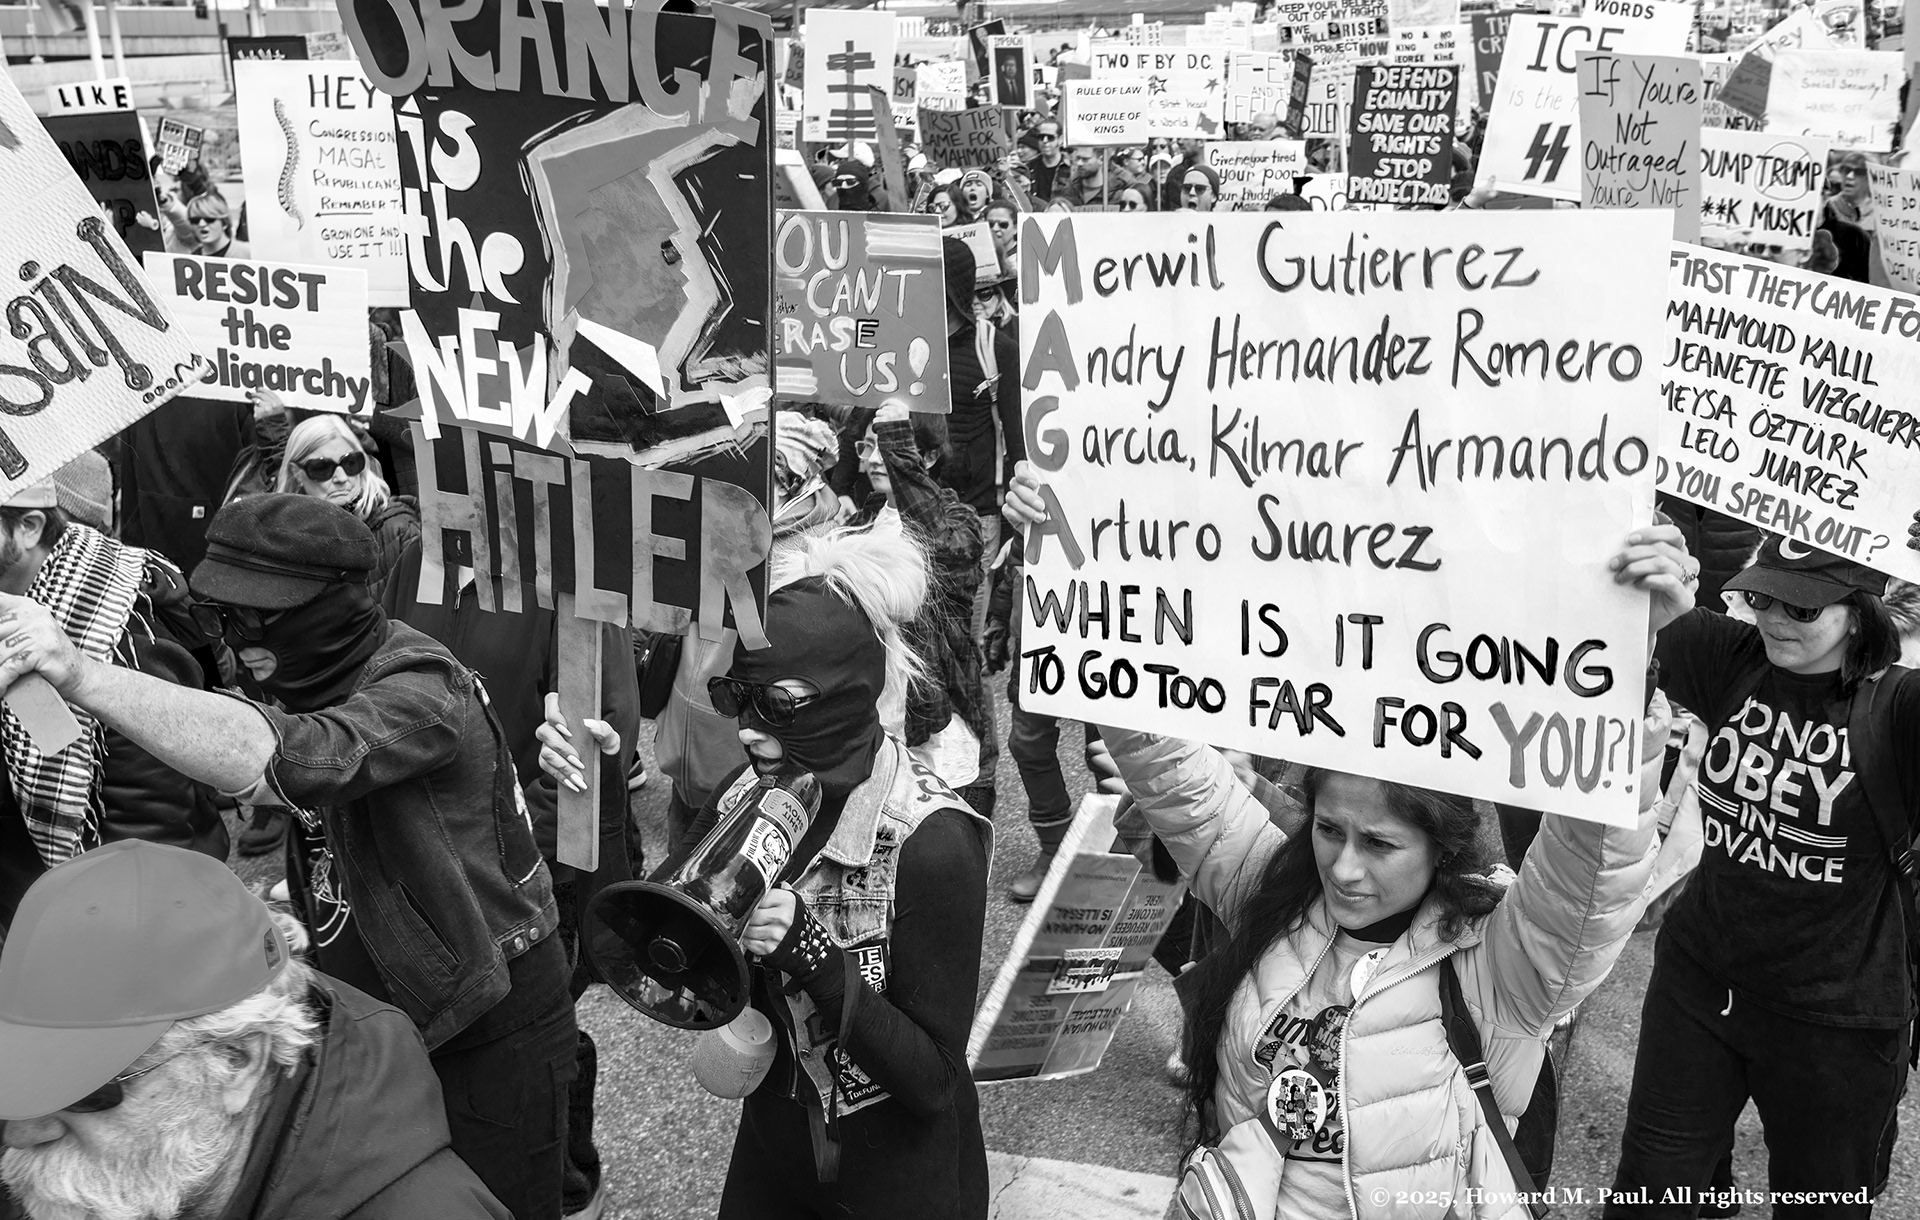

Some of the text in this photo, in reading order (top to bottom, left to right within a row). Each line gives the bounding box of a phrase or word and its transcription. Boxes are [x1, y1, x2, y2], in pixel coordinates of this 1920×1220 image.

[1277, 3, 1304, 13] KEEP
[1307, 1, 1338, 12] YOUR
[1288, 5, 1389, 22] OUT OF MY RIGHTS
[1594, 0, 1655, 20] WORDS
[1293, 21, 1375, 43] WE WILL RISE
[1401, 32, 1413, 40] NO
[1360, 41, 1389, 57] NOW
[1396, 43, 1416, 52] KING
[336, 0, 772, 147] ORANGE
[1096, 54, 1214, 70] TWO IF BY D.C.
[1371, 67, 1453, 90] DEFEND
[1584, 55, 1620, 107] If
[1801, 77, 1836, 89] Social
[58, 85, 128, 109] LIKE
[308, 74, 377, 109] HEY
[1077, 86, 1142, 96] RULE OF LAW
[1364, 89, 1452, 112] EQUALITY
[919, 108, 1002, 133] FIRST THEY
[1078, 112, 1141, 122] NOT RULE OF
[1357, 113, 1405, 135] SAVE
[1407, 113, 1450, 134] OUR
[1616, 111, 1658, 146] Not
[922, 130, 998, 148] CAME FOR
[1094, 125, 1125, 134] KINGS
[397, 95, 482, 192] is
[1370, 136, 1442, 156] RIGHTS
[933, 146, 1007, 168] MAHMOUD
[1272, 150, 1296, 163] tired
[1375, 158, 1432, 179] STOP
[1585, 140, 1687, 192] Outraged
[313, 168, 401, 191] REPUBLICANS
[1220, 168, 1299, 187] your poor
[1757, 155, 1822, 192] TRUMP
[1869, 168, 1899, 189] WHAT
[320, 196, 386, 210] REMEMBER
[1651, 178, 1689, 208] Not
[1751, 201, 1815, 238] MUSK!
[380, 226, 400, 238] AND
[400, 182, 525, 305] the
[328, 243, 353, 259] USE
[359, 242, 383, 258] IT
[776, 212, 849, 277] OU
[1021, 216, 1541, 305] Merwil Gutierrez
[173, 257, 326, 312] RESIST
[806, 265, 923, 319] CAN'T
[1670, 250, 1739, 295] FIRST
[1743, 263, 1811, 311] THEY
[1811, 280, 1881, 331] CAME
[220, 306, 291, 351] the
[1666, 299, 1879, 387] MAHMOUD KALIL
[1022, 308, 1643, 411] Andry Hernandez Romero
[1663, 337, 1789, 400] JEANETTE
[400, 307, 593, 450] NEW
[1025, 395, 1651, 492] Garcia, Kilmar Armando
[1749, 447, 1860, 511] JUAREZ
[1676, 461, 1722, 505] YOU
[1725, 481, 1813, 542] SPEAK
[1024, 484, 1442, 573] Arturo Suarez
[1025, 576, 1615, 698] WHEN IS IT GOING
[1021, 645, 1636, 795] TO GO TOO FAR FOR YOU?!
[1705, 727, 1856, 827] OBEY
[782, 801, 804, 831] SHOW
[782, 811, 799, 833] SHIT
[1739, 801, 1777, 840] IN
[1704, 815, 1846, 884] DVANCE
[1101, 909, 1113, 921] IS
[1087, 924, 1107, 935] NO
[1112, 922, 1151, 934] REFUGEES
